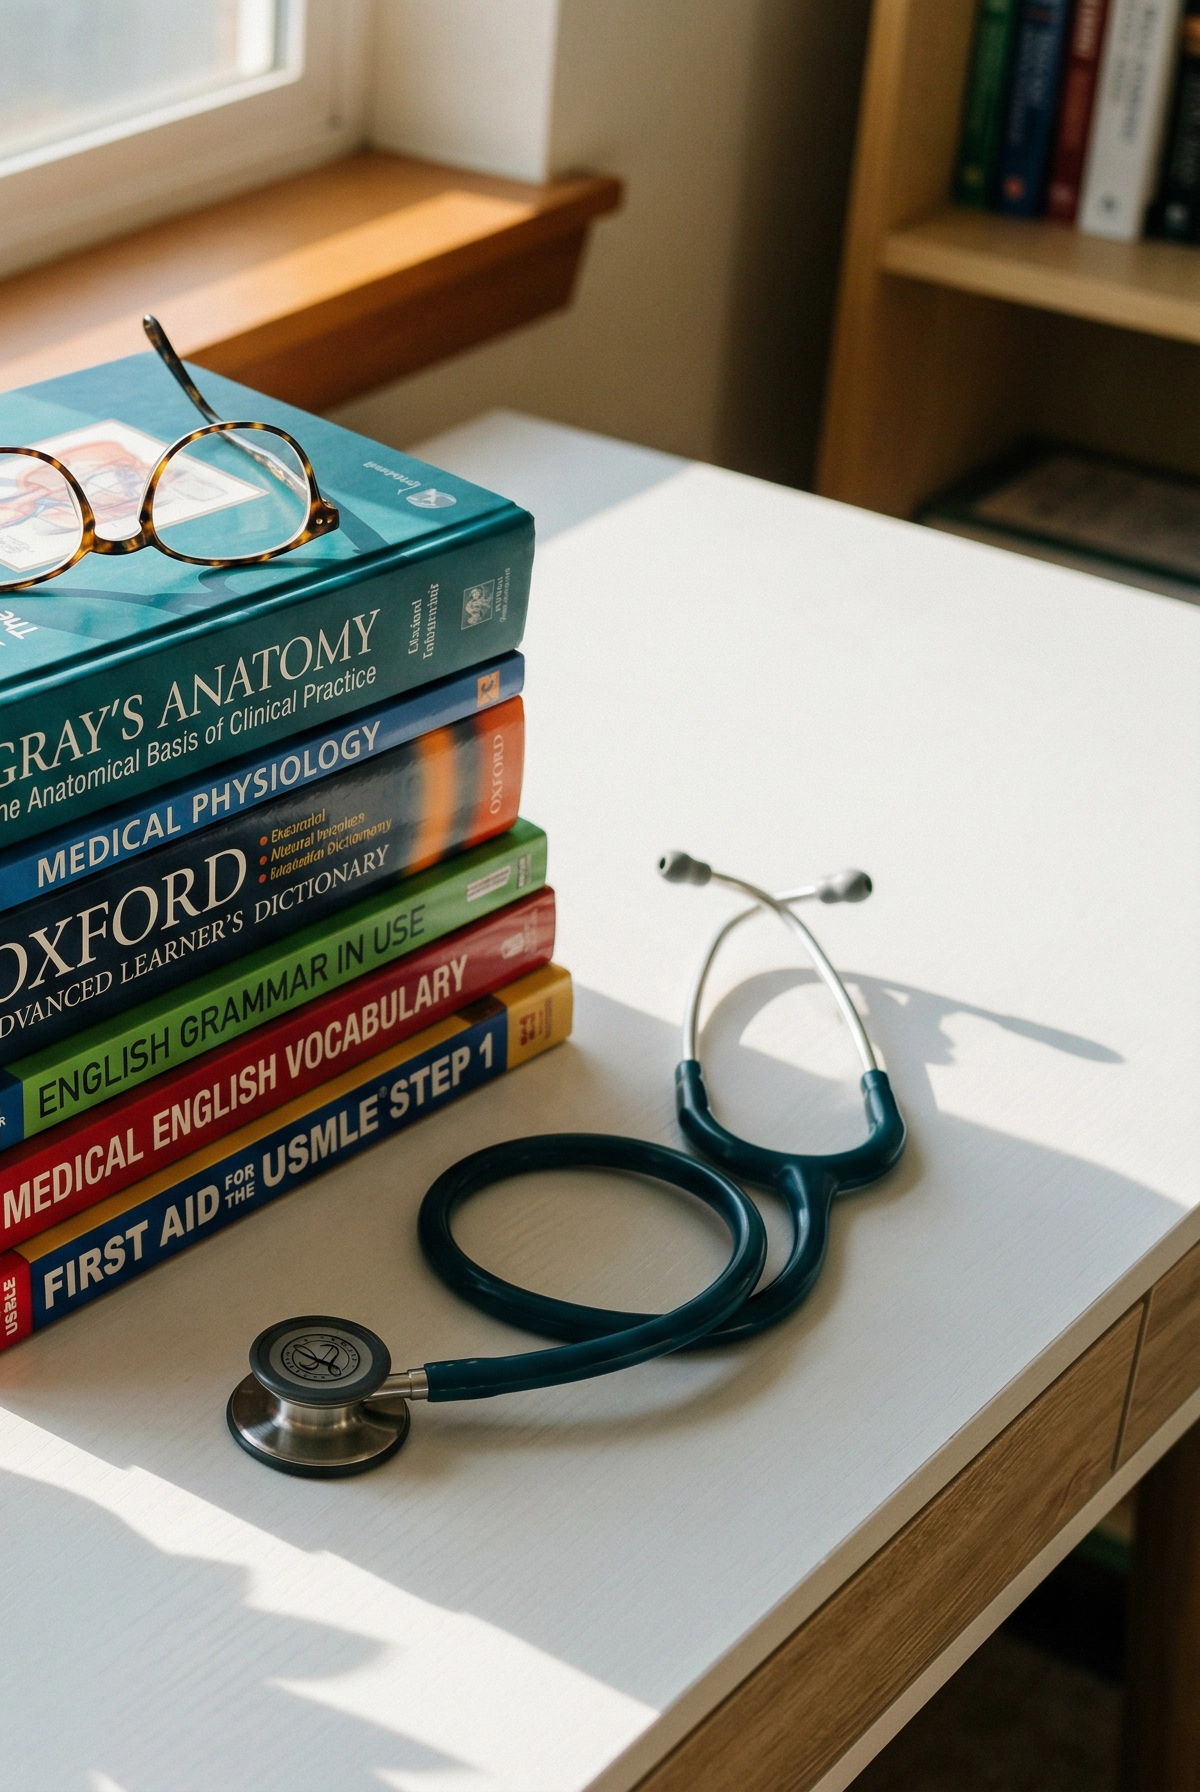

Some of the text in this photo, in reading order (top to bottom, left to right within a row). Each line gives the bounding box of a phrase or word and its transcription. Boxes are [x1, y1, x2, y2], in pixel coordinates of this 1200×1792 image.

[157, 608, 380, 729] ANATOMY
[27, 748, 140, 812] Anatomical
[147, 730, 198, 768] Basis
[205, 716, 224, 745] of
[230, 690, 297, 735] Clinical
[303, 665, 377, 708] Practice
[37, 721, 380, 888] MEDICAL PHYSIOLOGY
[120, 911, 243, 985] LEARNER'S
[254, 844, 389, 924] DICTIONARY
[39, 1026, 169, 1119] ENGLISH
[180, 953, 328, 1048] GRAMMAR
[338, 934, 364, 974] IN
[374, 904, 426, 955] USE
[390, 1045, 471, 1119] STEP
[479, 1032, 493, 1069] 1
[3, 1127, 144, 1229] MEDICAL
[153, 1054, 277, 1151] ENGLISH
[285, 954, 468, 1079] VOCABULARY
[225, 1163, 255, 1191] FOR
[225, 1181, 255, 1209] THE
[44, 1219, 148, 1310] FIRST
[159, 1184, 220, 1247] AID
